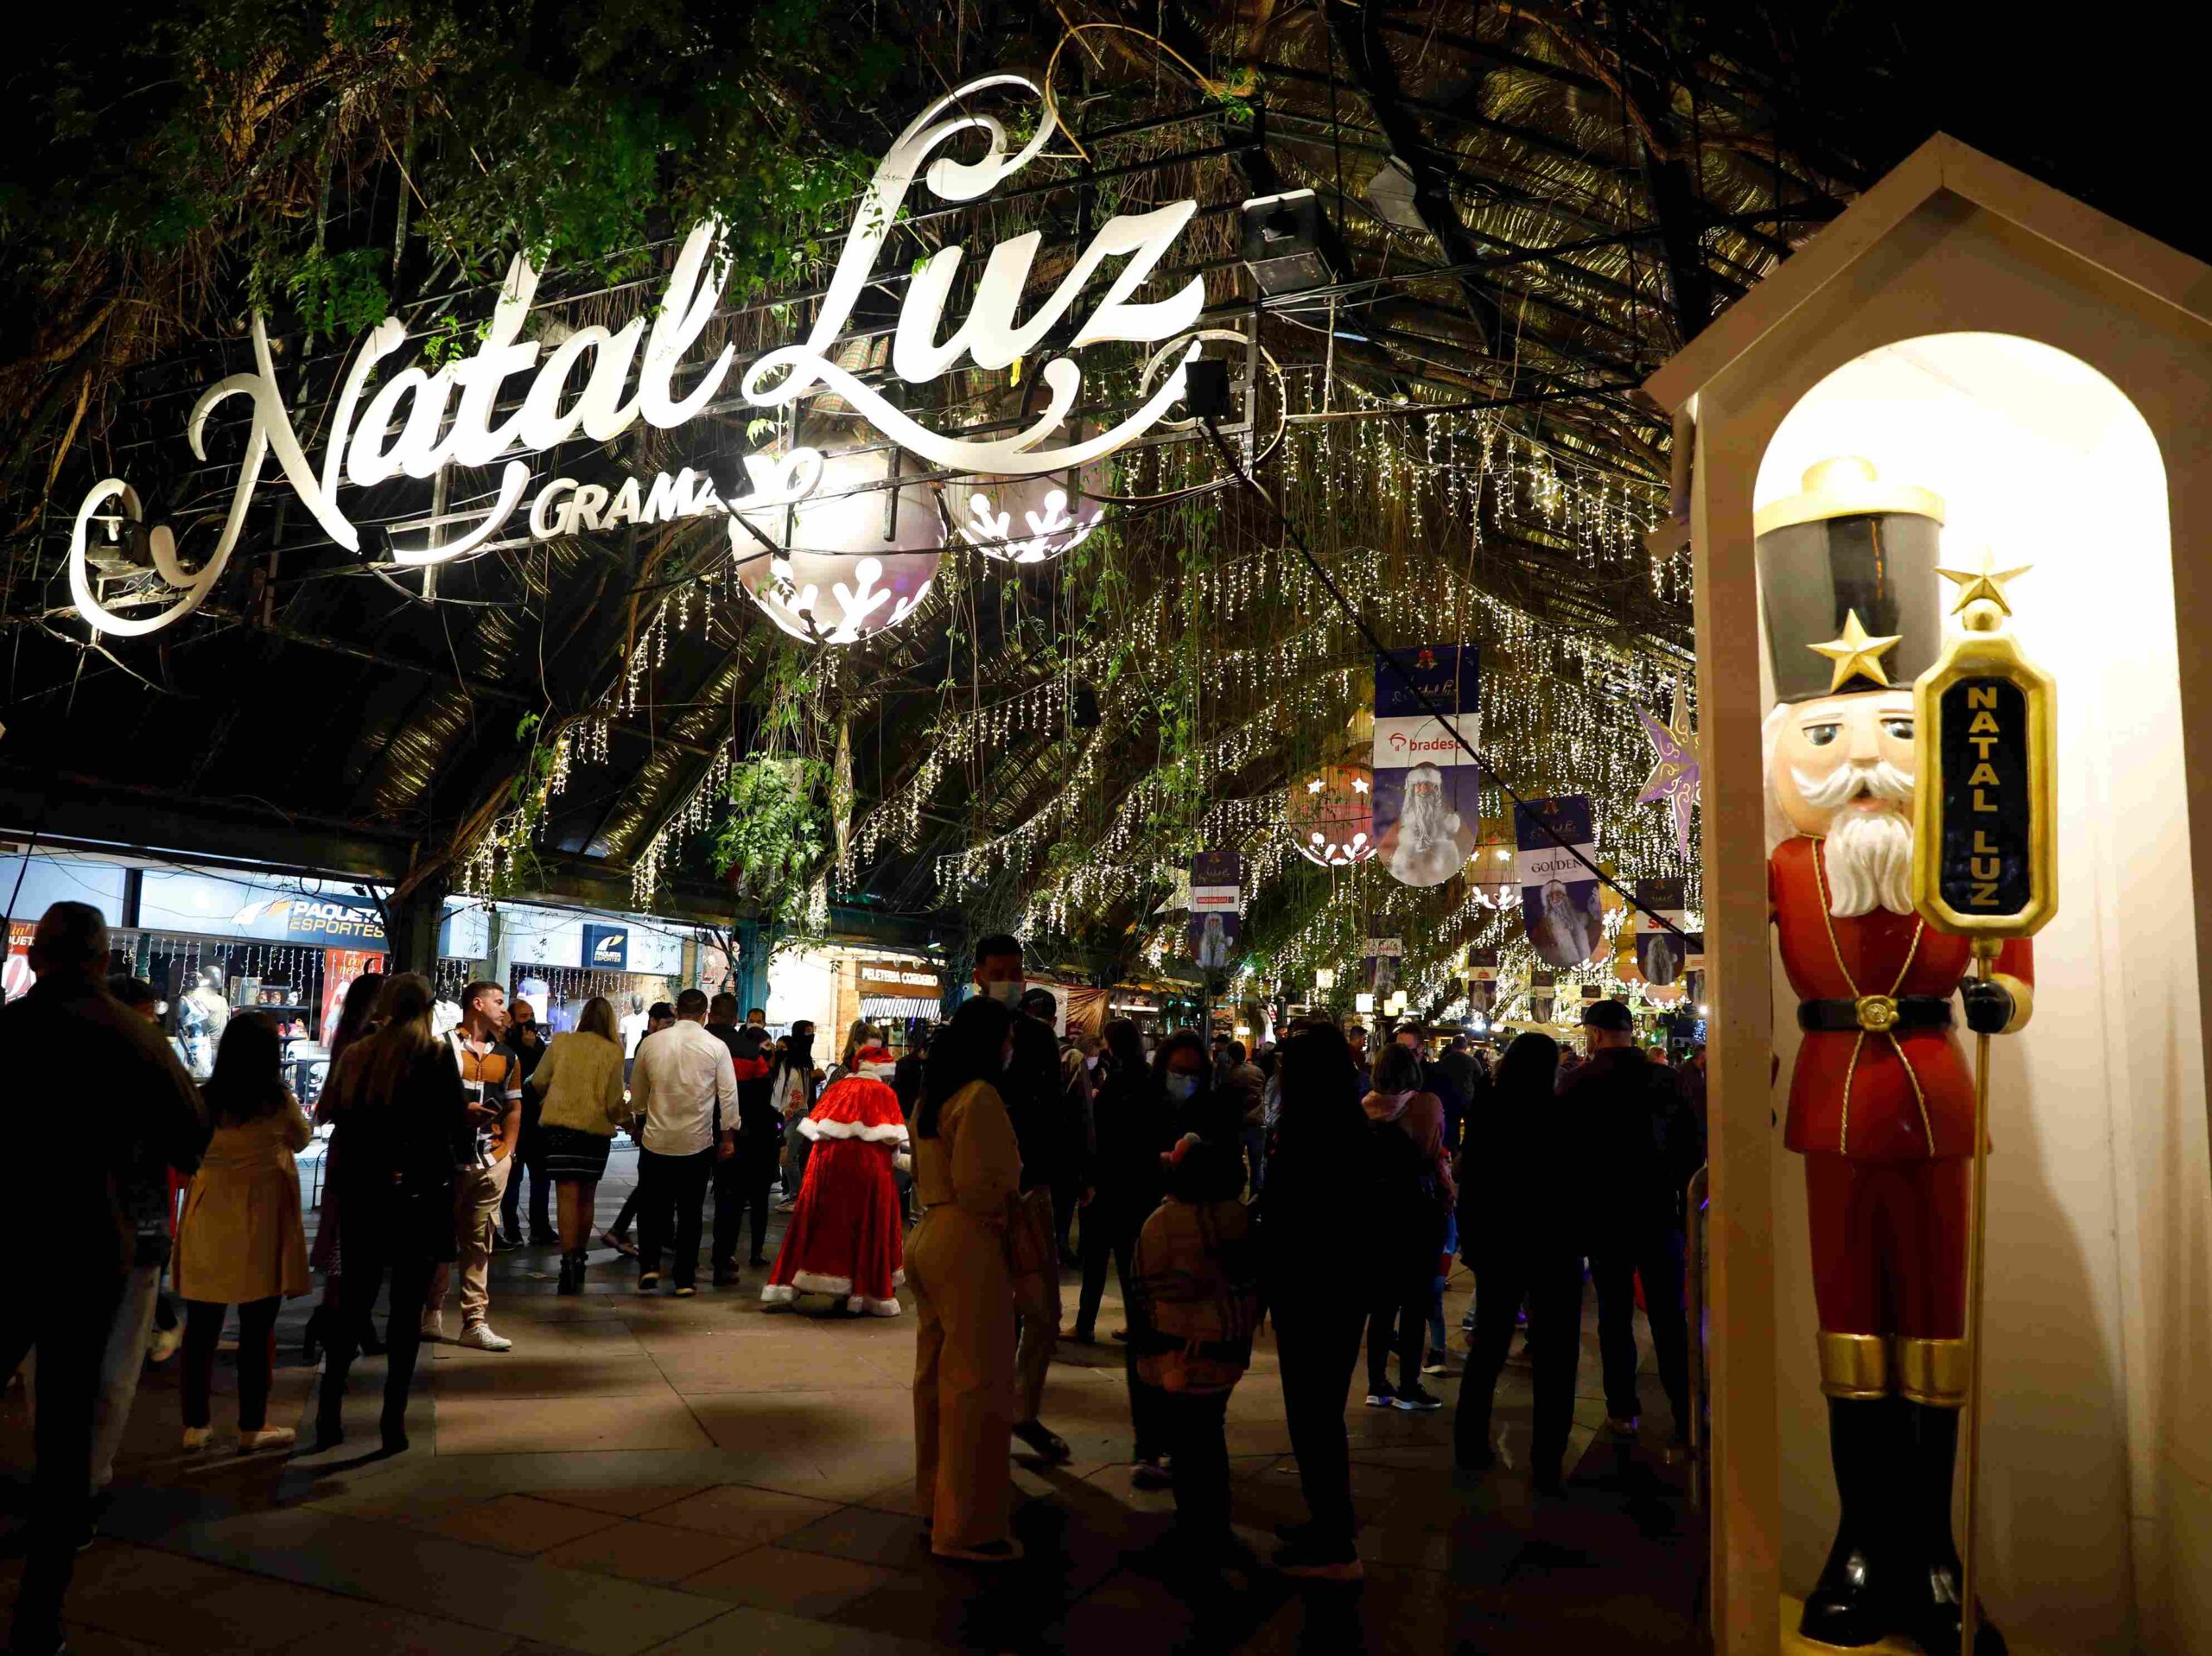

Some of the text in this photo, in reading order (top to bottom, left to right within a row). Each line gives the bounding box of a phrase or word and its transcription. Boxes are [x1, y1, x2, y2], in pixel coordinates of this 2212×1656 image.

[69, 73, 1206, 637] Natal Luz
[1967, 687, 2000, 905] NATAL LUZ
[1531, 859, 1583, 872] GOLDEN
[289, 918, 385, 938] ESPORTES
